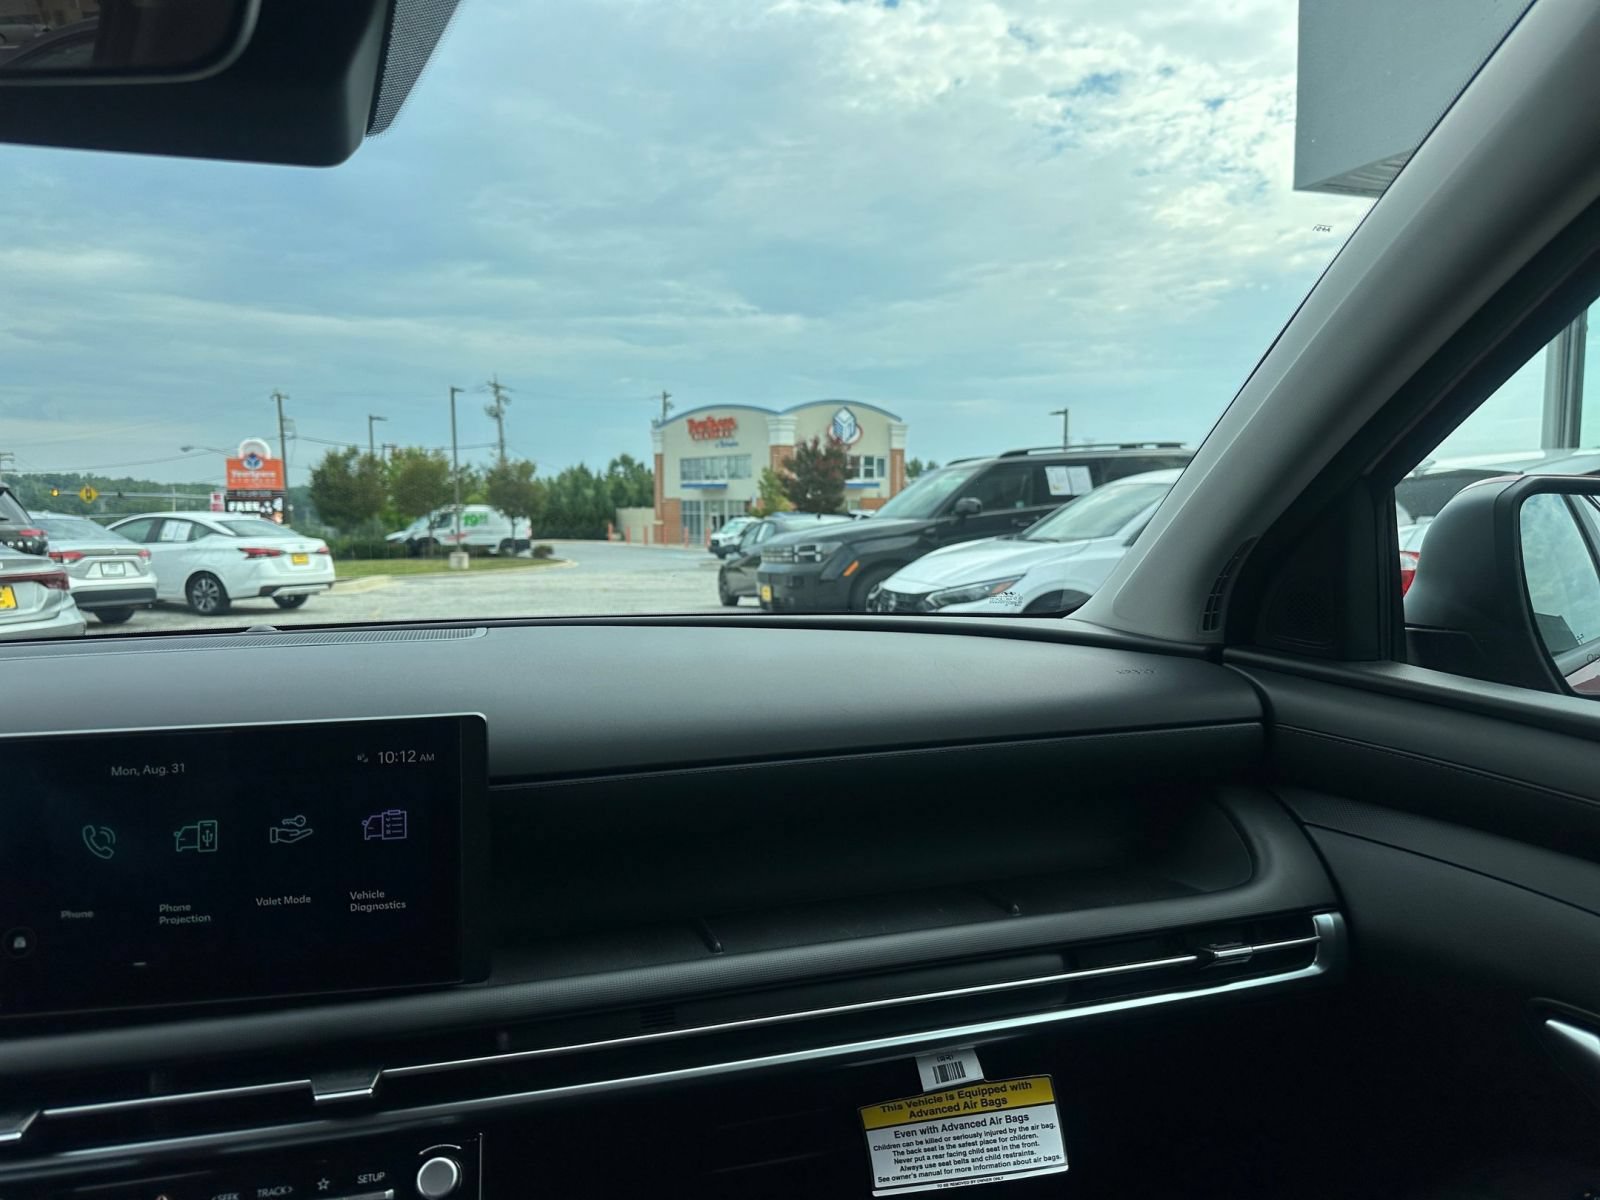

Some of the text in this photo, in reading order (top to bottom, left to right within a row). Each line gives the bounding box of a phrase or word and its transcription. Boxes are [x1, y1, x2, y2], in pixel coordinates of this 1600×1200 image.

[378, 749, 435, 764] 10:12 AM
[111, 762, 185, 777] Mon, Aug. 31
[256, 894, 312, 907] Valet Mode
[350, 890, 385, 900] Vehicle
[159, 904, 192, 912] Phone
[350, 900, 407, 913] Diagnostics
[60, 910, 94, 920] Phone
[159, 912, 212, 925] Projection
[881, 1081, 1032, 1112] This Vehicle is Equipped with
[909, 1097, 1008, 1119] Advanced Air Bags
[894, 1114, 1030, 1139] Even with Advanced Air Bags
[873, 1142, 900, 1152] Children
[952, 1132, 982, 1140] seriously
[984, 1128, 1008, 1138] injured
[958, 1140, 978, 1148] safest
[980, 1137, 997, 1146] place
[1010, 1132, 1039, 1141] children.
[894, 1156, 912, 1164] Never
[914, 1155, 926, 1163] put
[946, 1150, 967, 1158] facing
[968, 1147, 984, 1155] child
[1022, 1140, 1040, 1148] front.
[892, 1172, 917, 1182] owner's
[918, 1169, 942, 1178] manual
[973, 1160, 1011, 1170] information
[1012, 1158, 1032, 1166] about
[1044, 1154, 1062, 1162] bags.
[900, 1164, 923, 1172] Always
[954, 1157, 970, 1165] belts
[984, 1152, 1001, 1160] child
[1002, 1150, 1036, 1158] restraints.
[356, 1172, 386, 1185] SETUP
